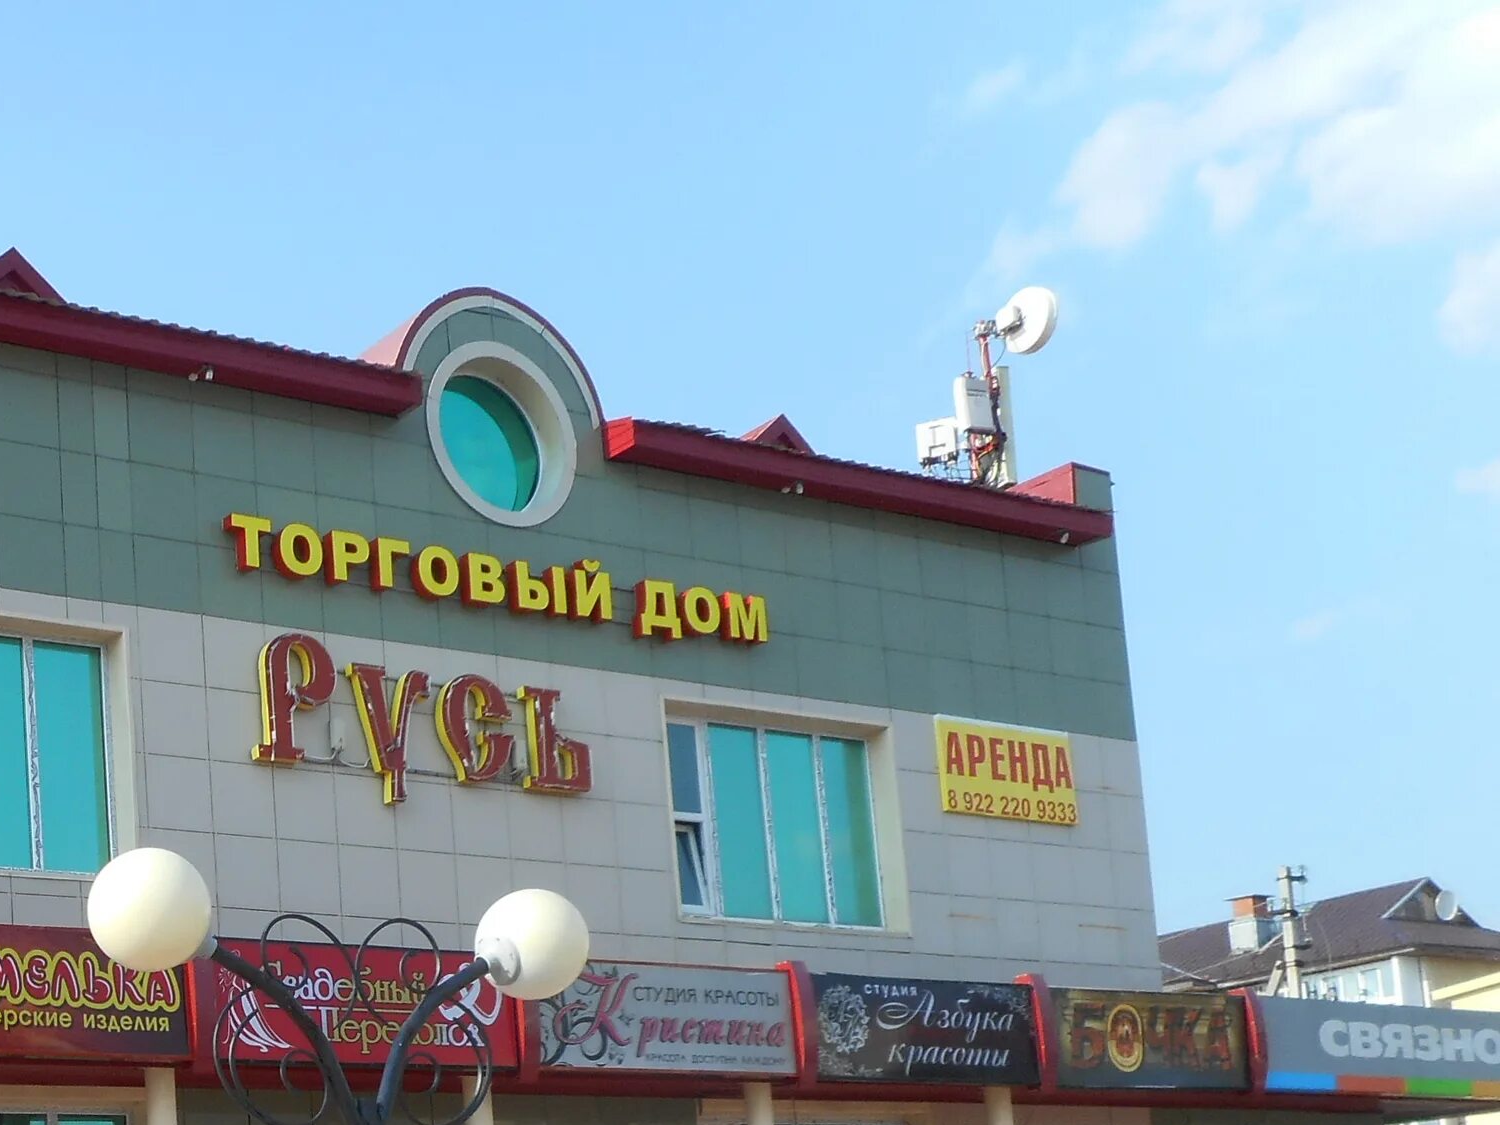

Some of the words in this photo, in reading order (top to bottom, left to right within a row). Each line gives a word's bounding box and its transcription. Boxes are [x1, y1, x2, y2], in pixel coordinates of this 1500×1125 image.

[222, 512, 613, 622] ТОРГОВЫЙ
[632, 579, 769, 646] ДОМ
[251, 633, 593, 804] РУСЬ
[946, 731, 1073, 793] АРЕНДА
[947, 789, 958, 810] 8
[963, 791, 995, 814] 922
[999, 796, 1031, 818] 220
[1037, 799, 1077, 823] 9333
[553, 972, 786, 1057] Кристина
[633, 986, 696, 1005] СТУДИЯ
[704, 988, 779, 1006] КРАСОТЫ
[876, 989, 1014, 1042] Азбука
[83, 1013, 170, 1033] изделия
[318, 1006, 485, 1054] Переолох
[1319, 1019, 1500, 1065] СВЯЗНО
[888, 1043, 1010, 1076] красоты
